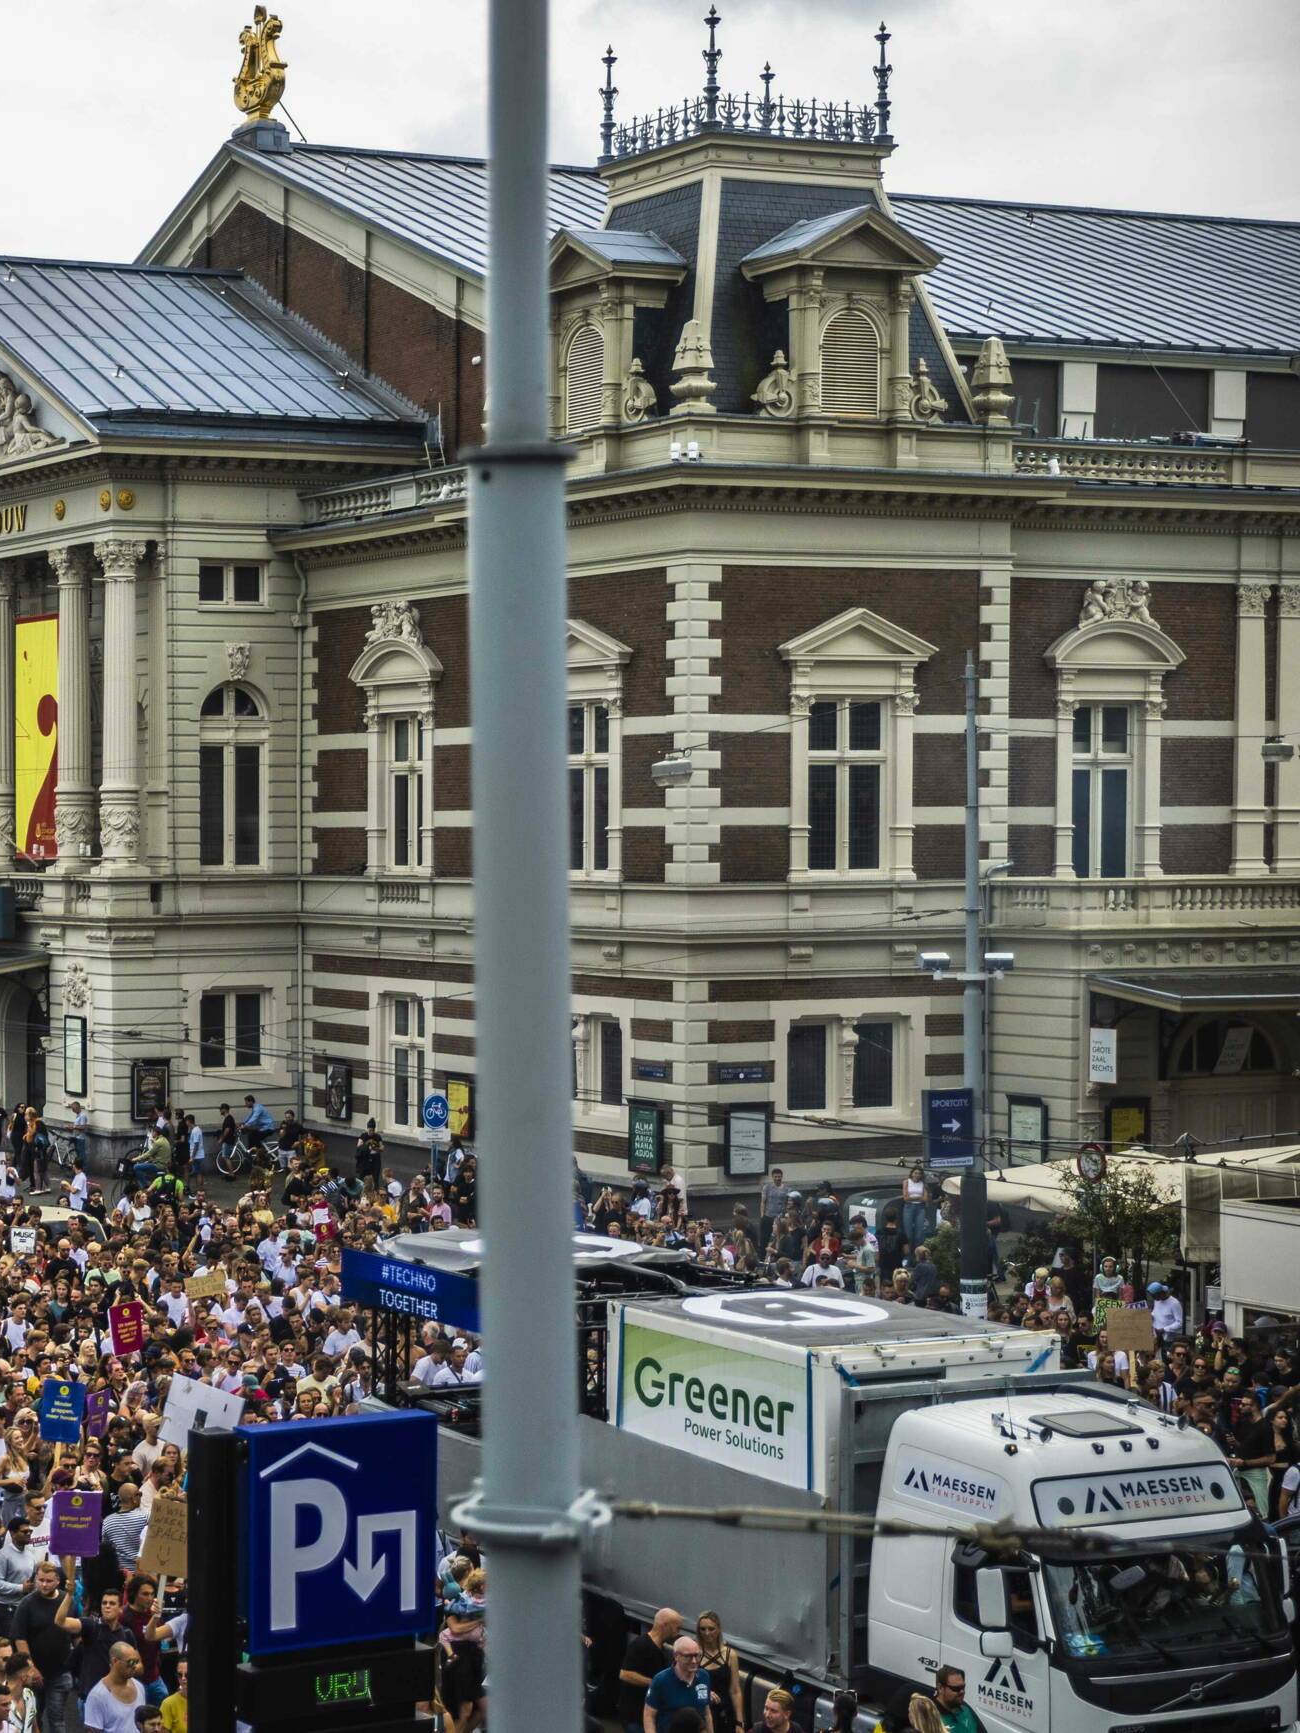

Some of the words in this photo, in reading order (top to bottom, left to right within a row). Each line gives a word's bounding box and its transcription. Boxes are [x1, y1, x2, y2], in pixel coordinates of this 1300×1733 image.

[1092, 1046, 1111, 1054] GROTE
[1092, 1055, 1106, 1063] ZAAL
[1092, 1064, 1113, 1073] RECHTS
[635, 1122, 653, 1130] ALMA
[381, 1263, 436, 1292] #TECHNO
[379, 1288, 438, 1319] TOGETHER
[634, 1356, 794, 1436] Greener
[684, 1417, 722, 1442] Power
[725, 1428, 784, 1460] Solutions
[932, 1472, 996, 1501] MAESSEN
[1119, 1475, 1203, 1498] MAESSEN
[931, 1487, 994, 1511] TENTSUPPLY
[1126, 1494, 1207, 1510] TENTSUPPLY
[270, 1477, 348, 1632] P
[918, 1656, 938, 1668] 430
[978, 1684, 1033, 1711] MAESSEN
[978, 1696, 1033, 1718] TENTSUPPLY
